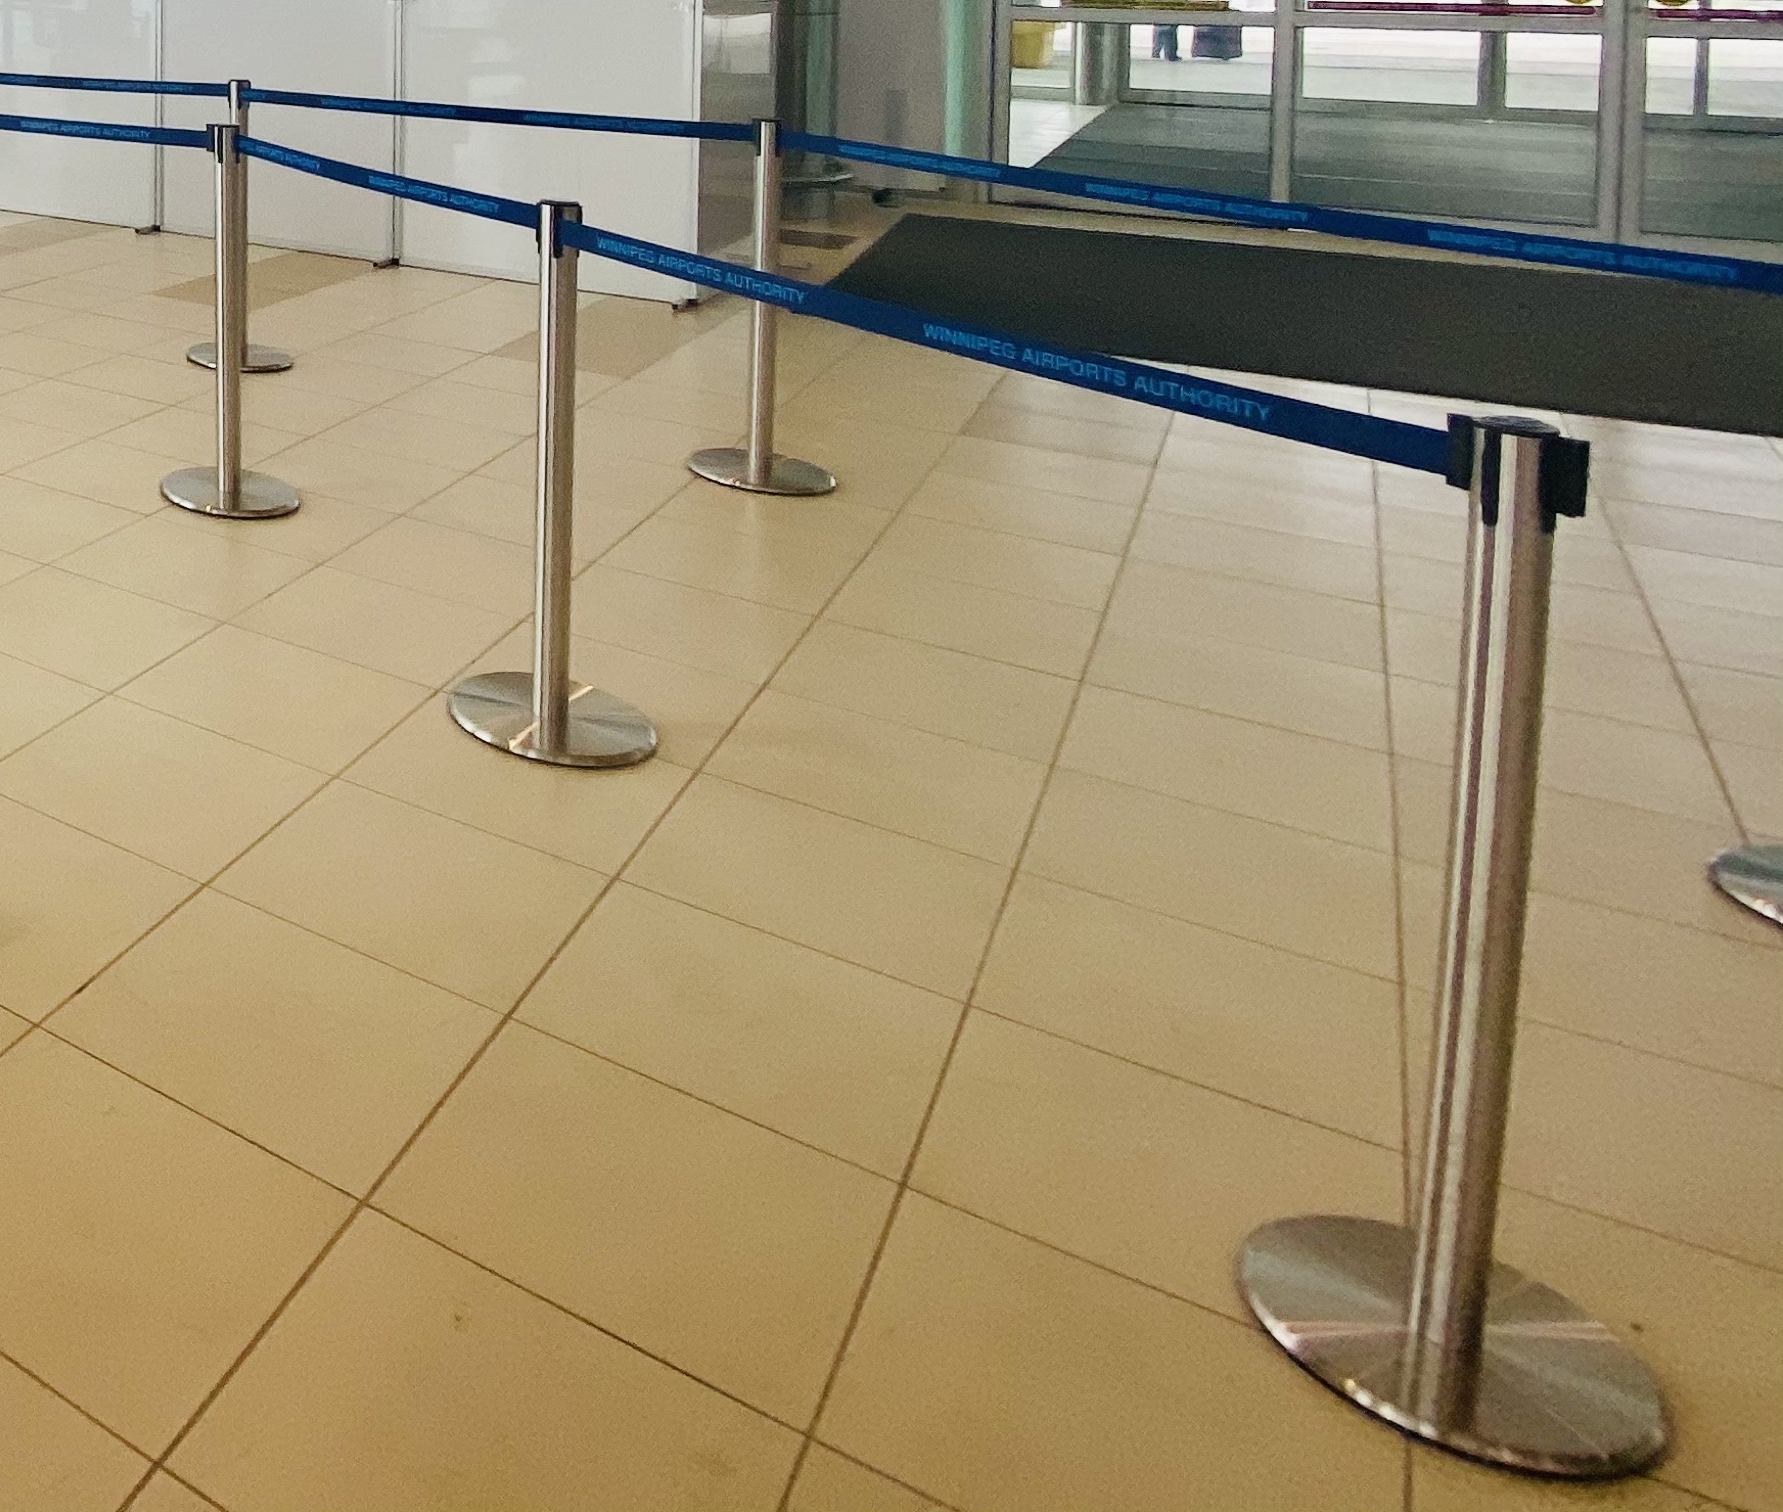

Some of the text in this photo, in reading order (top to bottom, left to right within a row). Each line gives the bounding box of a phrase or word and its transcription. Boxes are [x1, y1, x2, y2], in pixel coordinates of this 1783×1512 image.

[596, 234, 809, 304] WINNIPEG AIRPORTS AUTHORITY
[922, 322, 1270, 421] WINNIPEG AIRPORTS AUTHORITY
